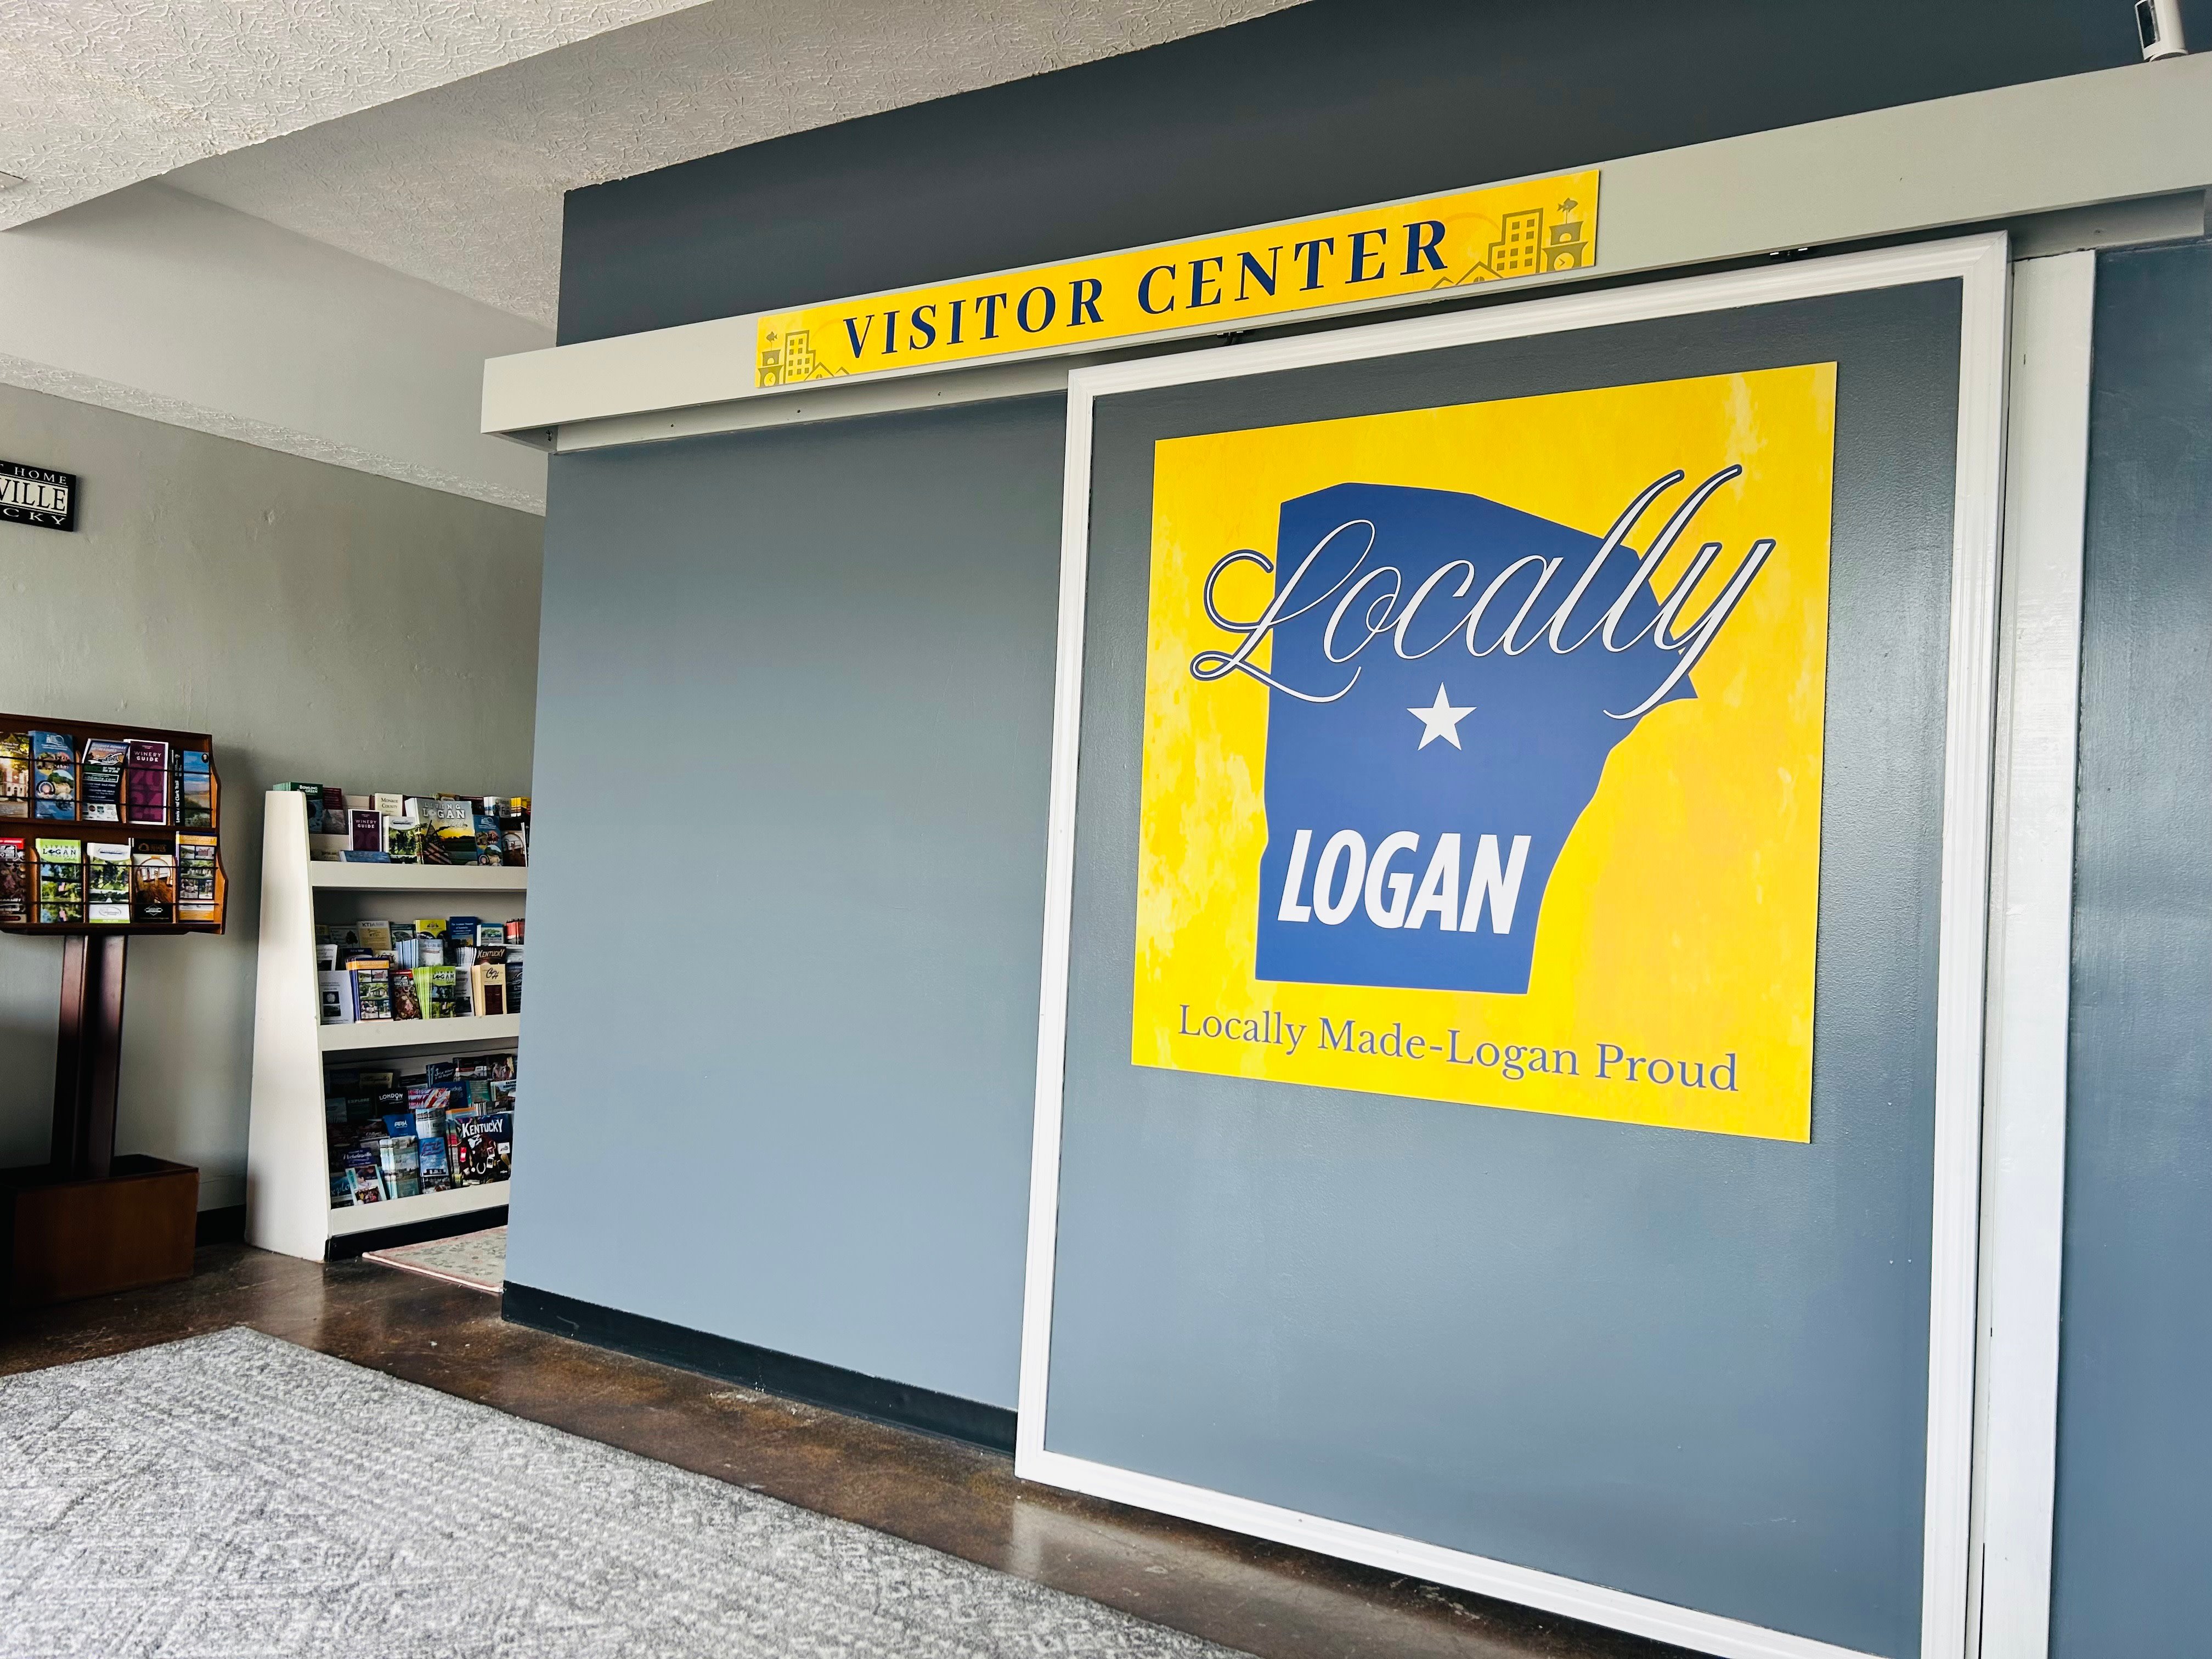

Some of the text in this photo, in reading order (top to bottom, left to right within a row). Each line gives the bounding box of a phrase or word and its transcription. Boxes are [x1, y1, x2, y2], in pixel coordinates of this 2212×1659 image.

[843, 219, 1448, 359] VISITOR CENTER
[14, 466, 67, 485] HOME
[1189, 464, 1776, 719] Locally
[1276, 828, 1532, 935] LOGAN
[477, 948, 505, 959] KENTUCKY
[1178, 1004, 1740, 1092] Locally Made-Logan Proud
[379, 1092, 403, 1101] LONDON
[461, 1119, 503, 1138] KENTUCKY
